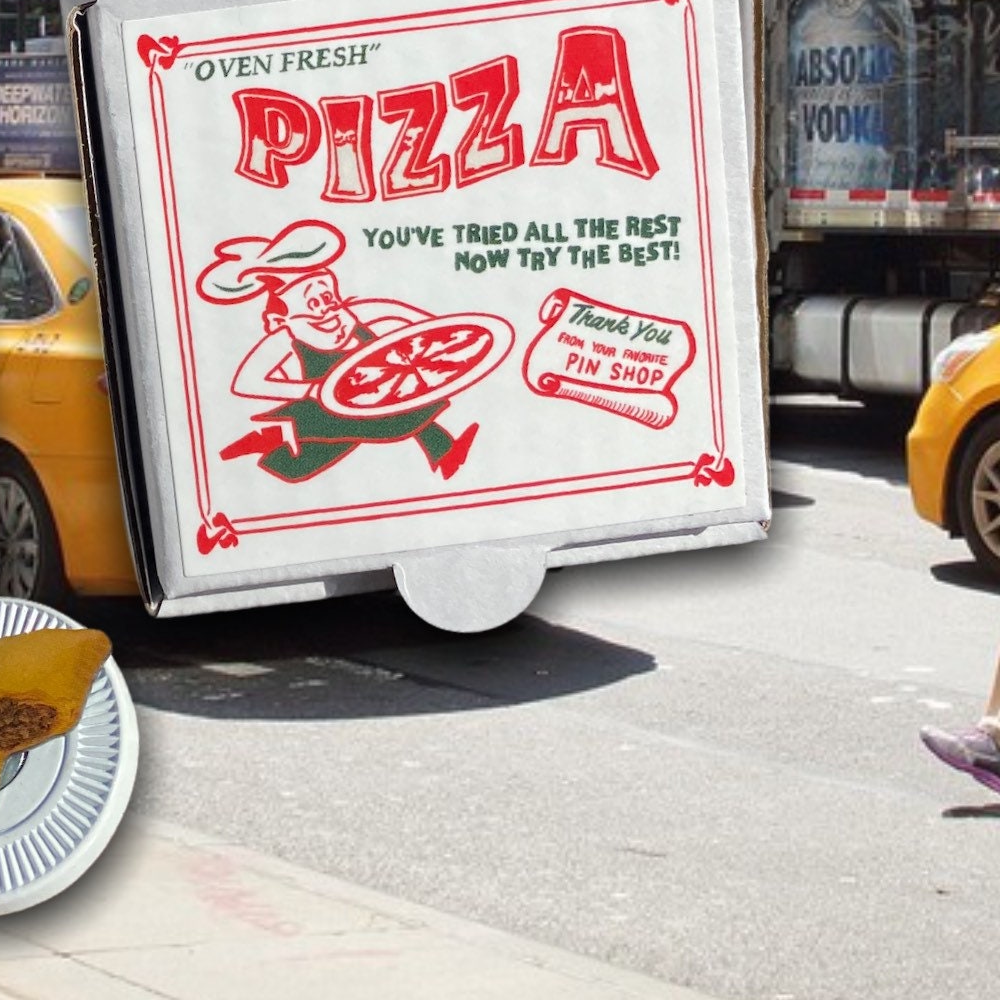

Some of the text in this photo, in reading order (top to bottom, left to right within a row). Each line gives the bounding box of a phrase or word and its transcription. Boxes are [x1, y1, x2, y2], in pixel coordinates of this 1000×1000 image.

[184, 42, 382, 82] "OVEN FRESH"
[231, 25, 661, 203] PIZZA
[362, 214, 682, 250] YOU'VE TRIED ALL THE REST
[454, 240, 680, 274] NOW TRY THE BEST!
[568, 303, 673, 346] Thank You
[557, 332, 669, 366] FROM YOUR FAVORITE
[565, 352, 665, 386] PIN SHOP
